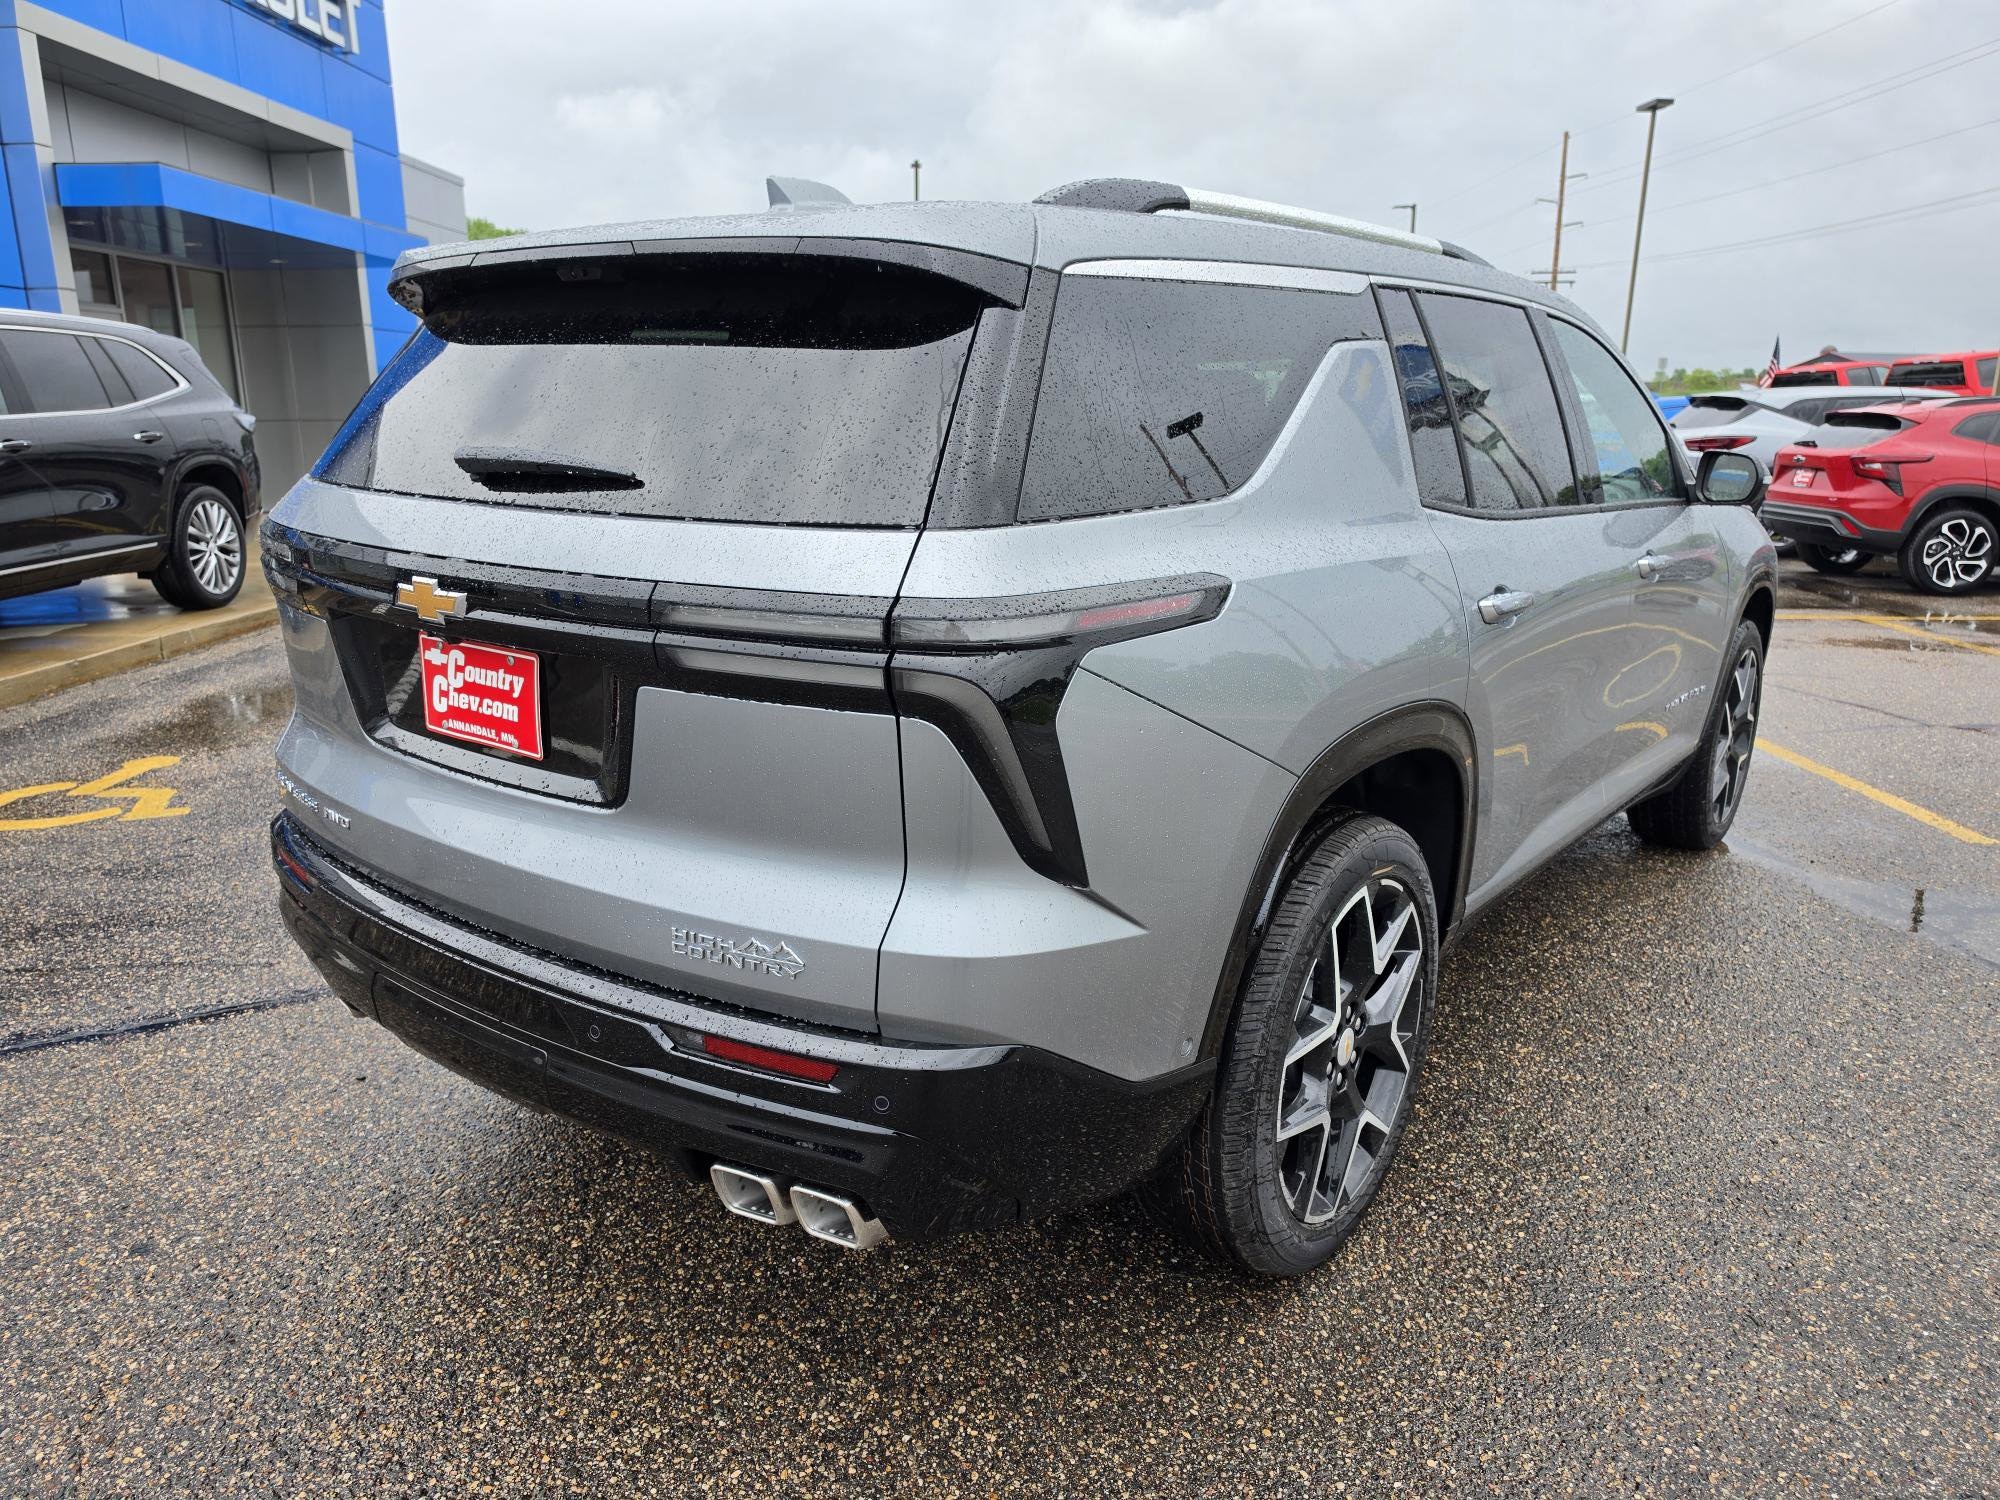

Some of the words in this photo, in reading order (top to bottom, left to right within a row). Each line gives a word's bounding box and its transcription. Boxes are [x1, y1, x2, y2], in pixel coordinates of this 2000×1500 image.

[447, 649, 524, 699] Country
[433, 675, 519, 723] Chev.com
[448, 718, 499, 742] ANNANDALE,
[671, 926, 736, 952] HIGH
[671, 940, 805, 981] COUNTRY
